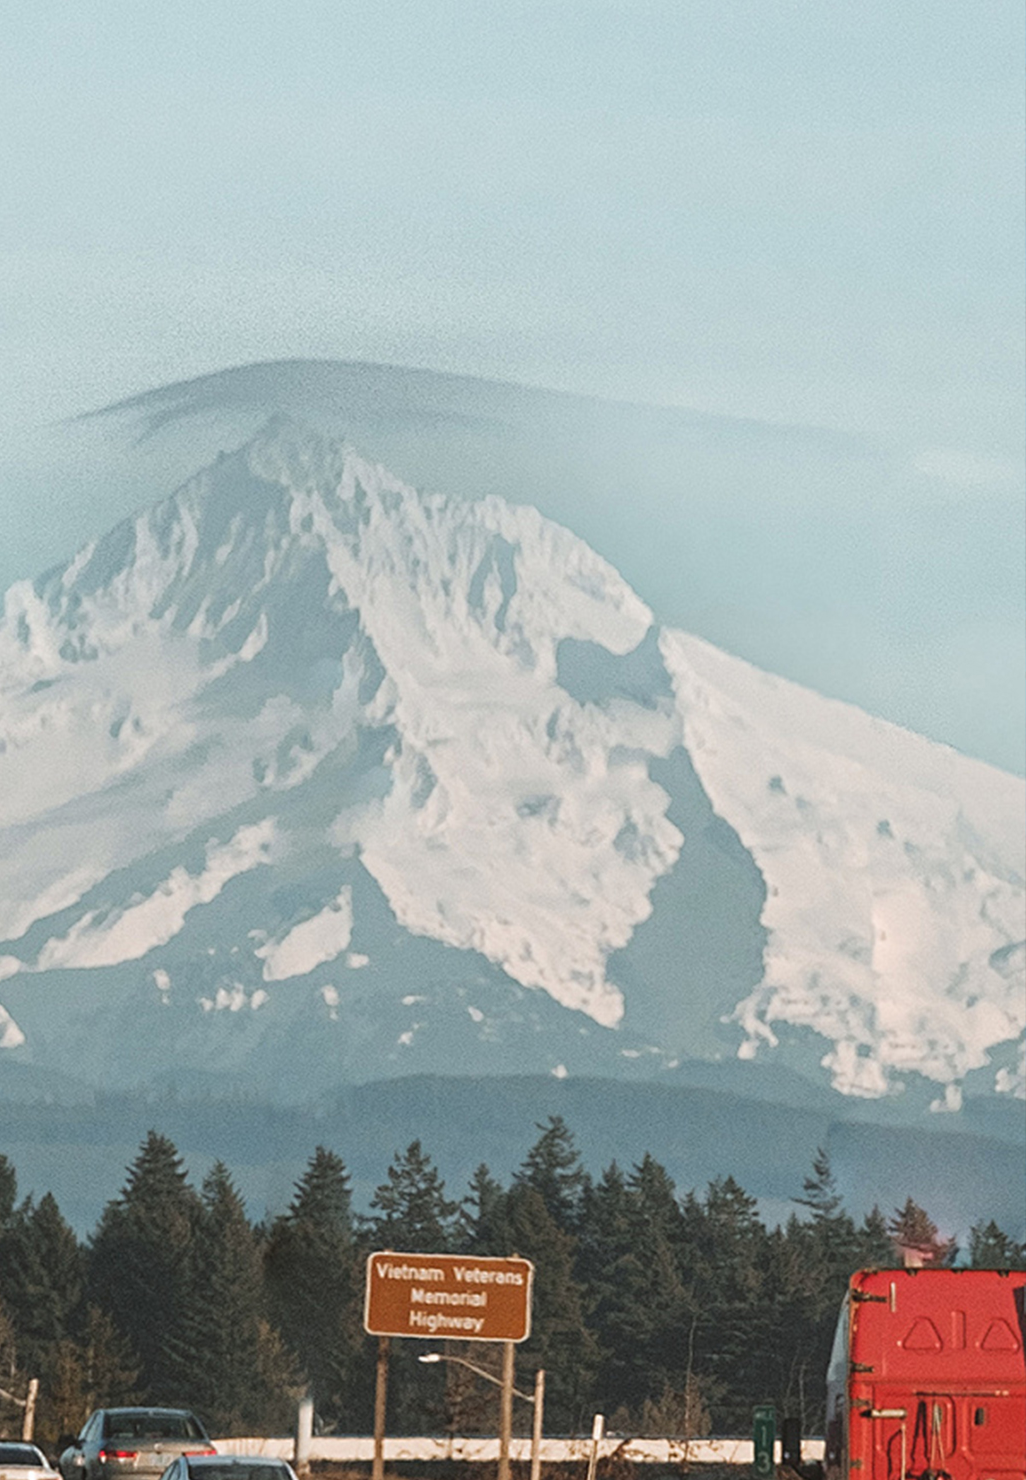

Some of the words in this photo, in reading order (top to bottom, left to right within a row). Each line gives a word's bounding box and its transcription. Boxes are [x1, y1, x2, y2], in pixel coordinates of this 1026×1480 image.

[376, 1263, 444, 1281] Vietnam
[453, 1267, 523, 1286] Veterans
[411, 1288, 486, 1307] Memorial
[409, 1310, 485, 1333] Highway
